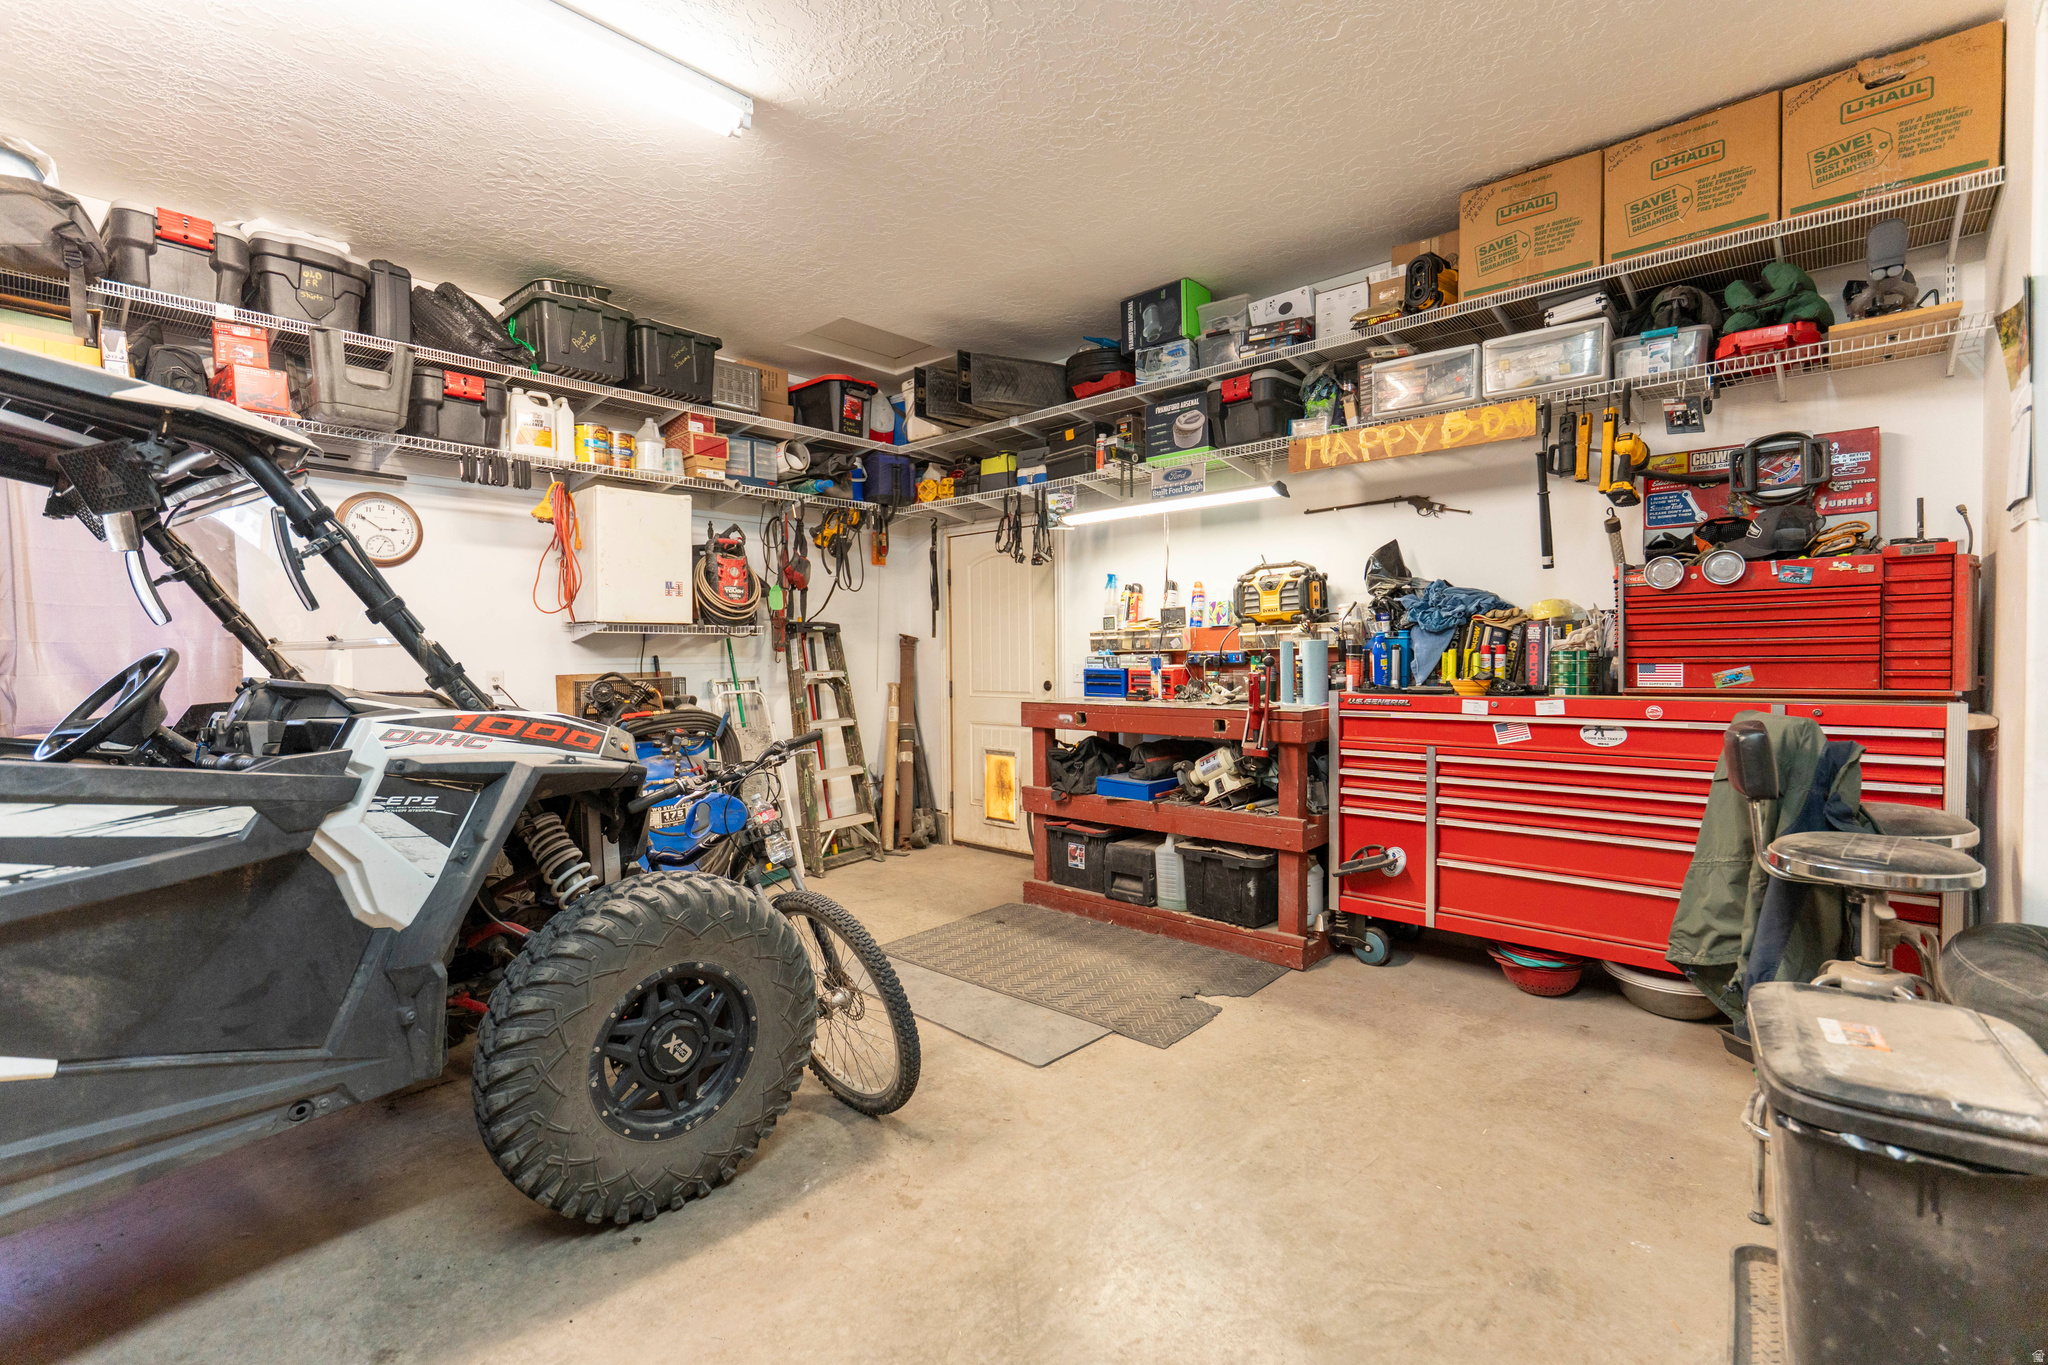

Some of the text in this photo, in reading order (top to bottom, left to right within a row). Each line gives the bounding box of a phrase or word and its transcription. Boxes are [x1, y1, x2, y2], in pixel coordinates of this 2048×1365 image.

[1846, 81, 1928, 114] U-HAUL
[1898, 124, 1919, 134] SAVE
[1921, 118, 1942, 128] EVEN
[1898, 131, 1916, 141] Beat
[1918, 127, 1931, 136] Our
[1924, 132, 1939, 140] and
[1655, 145, 1721, 171] U-HAUL
[1813, 133, 1872, 164] SAVE!
[1815, 150, 1874, 177] BEST PRICE
[1500, 195, 1554, 218] U-HAUL
[1630, 189, 1677, 215] SAVE!
[1631, 204, 1678, 226] BEST PRICE
[1479, 234, 1518, 257] SAVE!
[1480, 247, 1518, 267] BEST PRICE
[302, 270, 322, 280] OLD
[305, 279, 318, 287] FR
[1155, 398, 1199, 415] FRANKFORD ARSENAL
[1304, 421, 1436, 469] HAPPY
[1168, 469, 1187, 481] Ford
[1152, 483, 1203, 497] Built Ford Tough
[1529, 643, 1538, 686] CHILTON
[1364, 698, 1412, 707] GENERAL
[379, 729, 493, 750] DOHC
[453, 714, 602, 750] 1000
[1200, 754, 1217, 767] JET
[386, 795, 439, 806] EPS
[664, 810, 684, 819] 175
